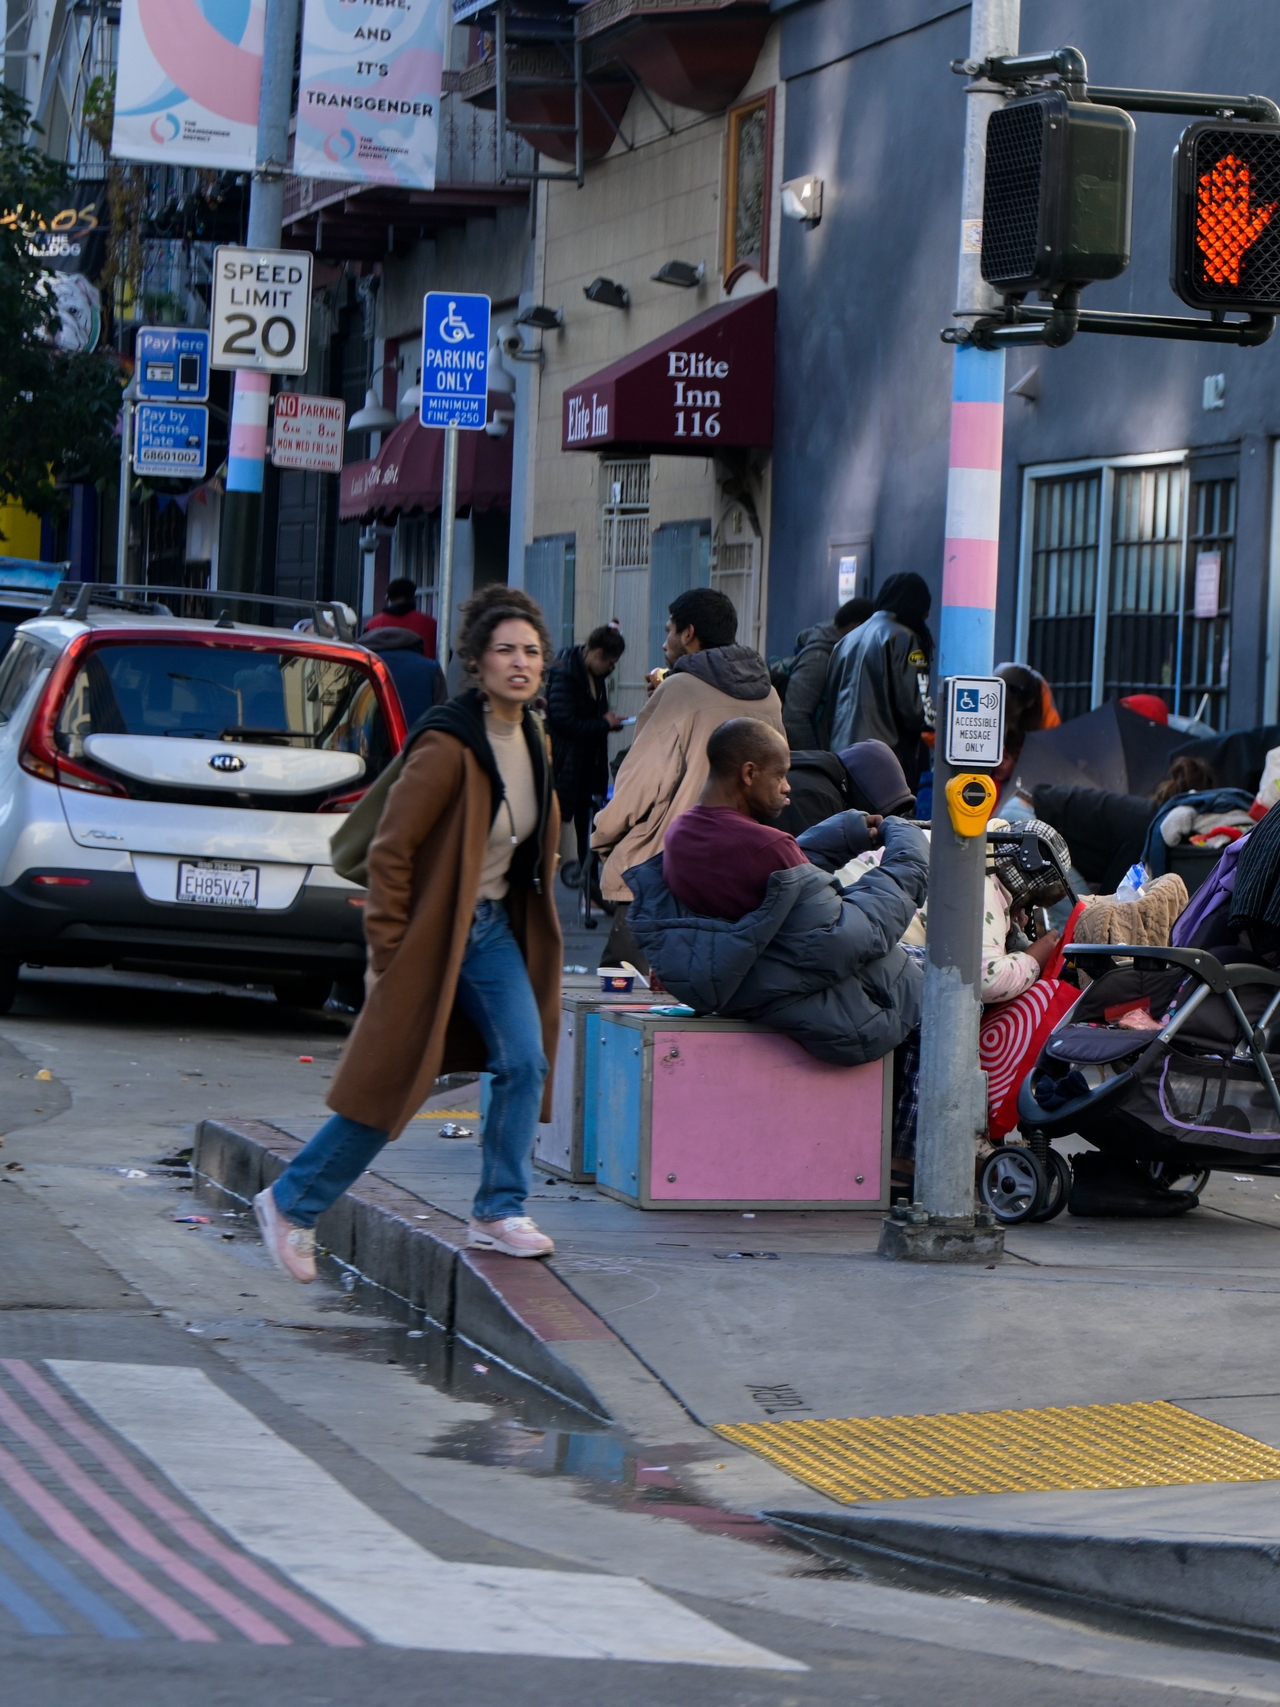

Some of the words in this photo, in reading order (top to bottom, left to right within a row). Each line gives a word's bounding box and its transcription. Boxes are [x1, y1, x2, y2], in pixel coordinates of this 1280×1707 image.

[354, 26, 391, 42] AND
[357, 61, 389, 77] IT'S
[307, 90, 433, 117] TRANSGENDER
[184, 127, 230, 137] TRANSGENDER
[359, 144, 409, 155] TRANSGENDER
[223, 262, 303, 285] SPEED
[230, 287, 292, 308] LIMIT
[144, 335, 170, 353] Pay
[172, 336, 204, 352] here
[222, 313, 296, 358] 20
[426, 348, 485, 371] PARKING
[667, 351, 729, 378] Elite
[436, 371, 473, 391] ONLY
[674, 381, 722, 408] Inn
[278, 396, 297, 415] NO
[300, 402, 340, 420] PARKING
[429, 398, 479, 411] MINIMUM
[142, 407, 166, 425] Pay
[170, 408, 186, 425] by
[427, 410, 449, 422] FINE
[455, 411, 480, 424] $250
[567, 394, 590, 442] Elite
[591, 392, 608, 438] Inn
[674, 411, 721, 437] 116
[142, 421, 189, 436] License
[141, 433, 174, 448] Plate
[277, 437, 292, 449] MON
[295, 439, 310, 452] WED
[312, 441, 323, 454] FRI
[326, 443, 338, 456] SAT
[279, 455, 302, 466] STREET
[305, 457, 336, 470] CLEANING
[955, 716, 997, 728] ACCESSIBLE
[959, 730, 991, 740] MESSAGE
[965, 743, 984, 753] ONLY
[213, 756, 240, 769] KIA
[185, 876, 250, 898] EH85V47
[744, 1384, 813, 1414] TURK
